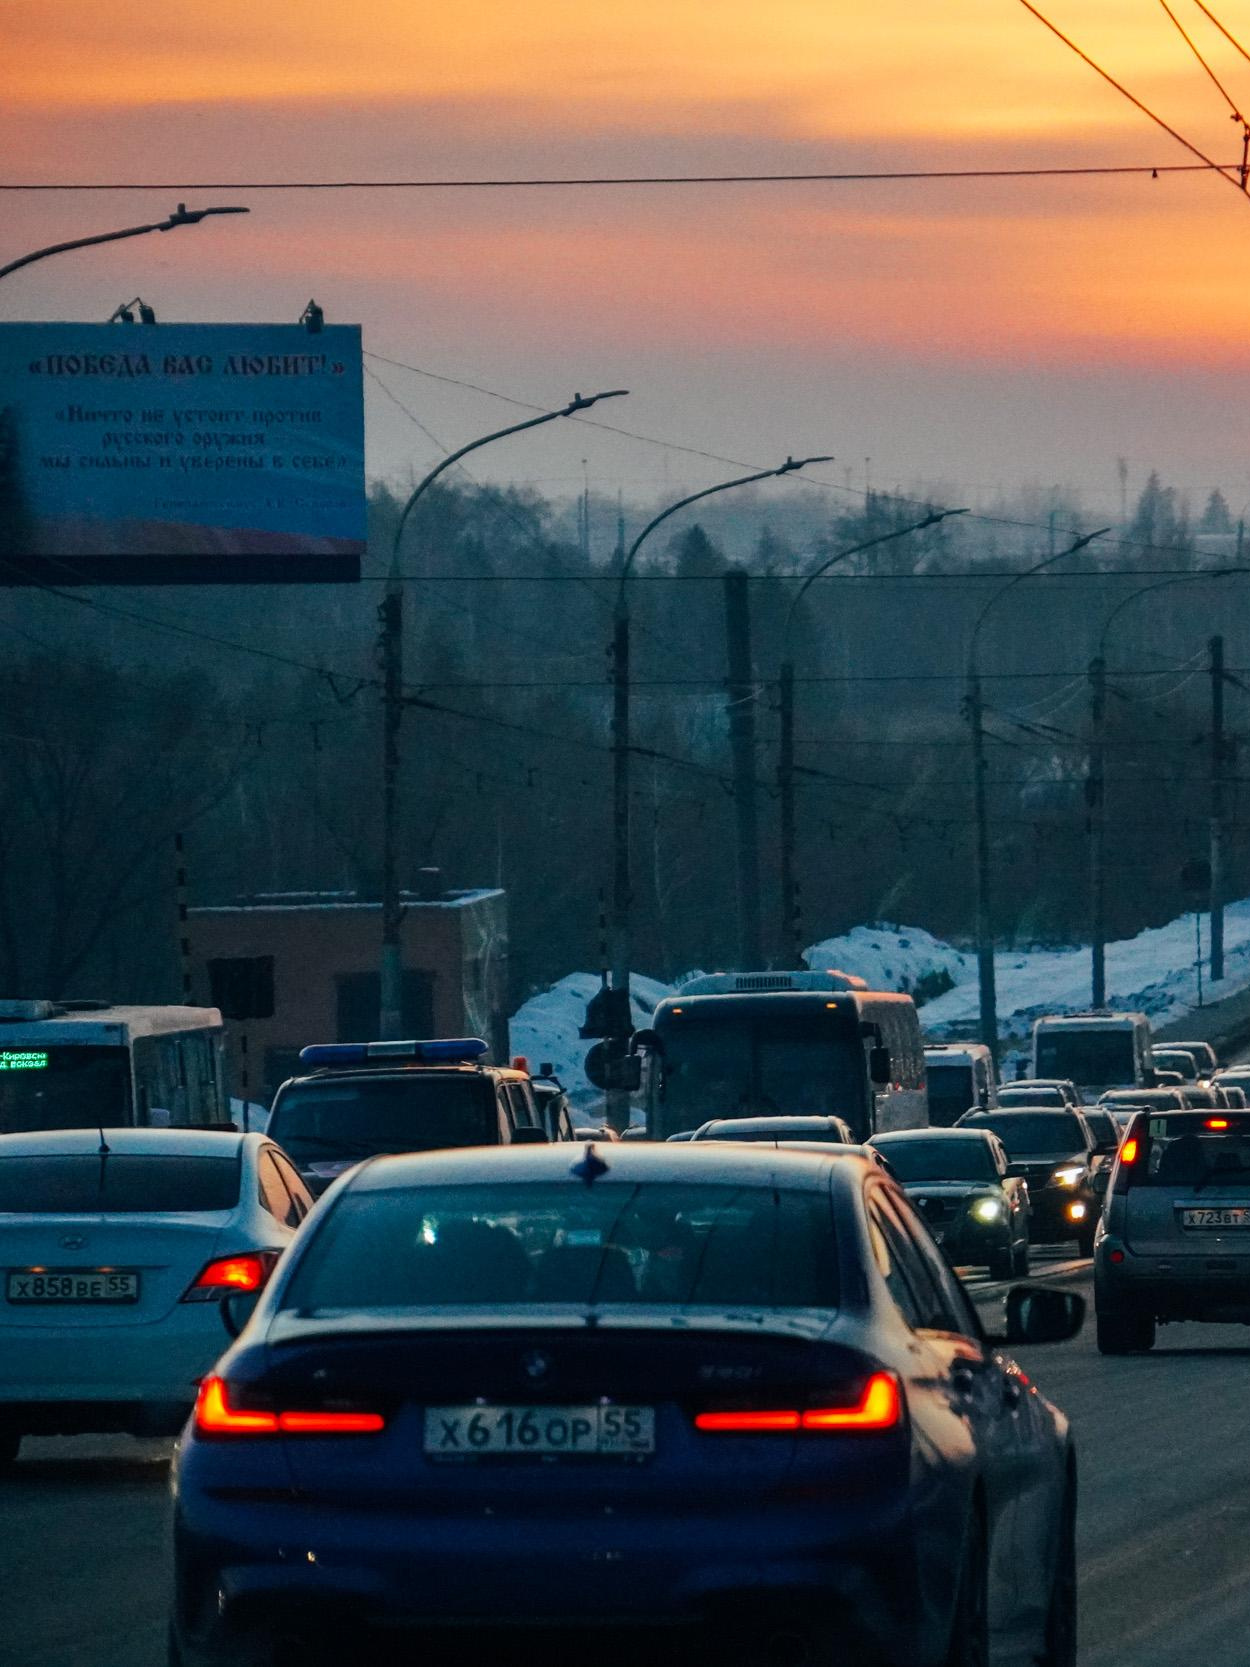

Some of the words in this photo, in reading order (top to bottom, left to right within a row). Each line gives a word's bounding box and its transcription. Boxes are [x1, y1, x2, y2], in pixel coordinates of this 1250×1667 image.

[163, 354, 213, 375] ВАС
[141, 409, 164, 423] не
[173, 408, 244, 427] устоит
[252, 407, 322, 427] против
[79, 455, 150, 469] сильны
[160, 456, 171, 469] и
[180, 455, 263, 473] уверены
